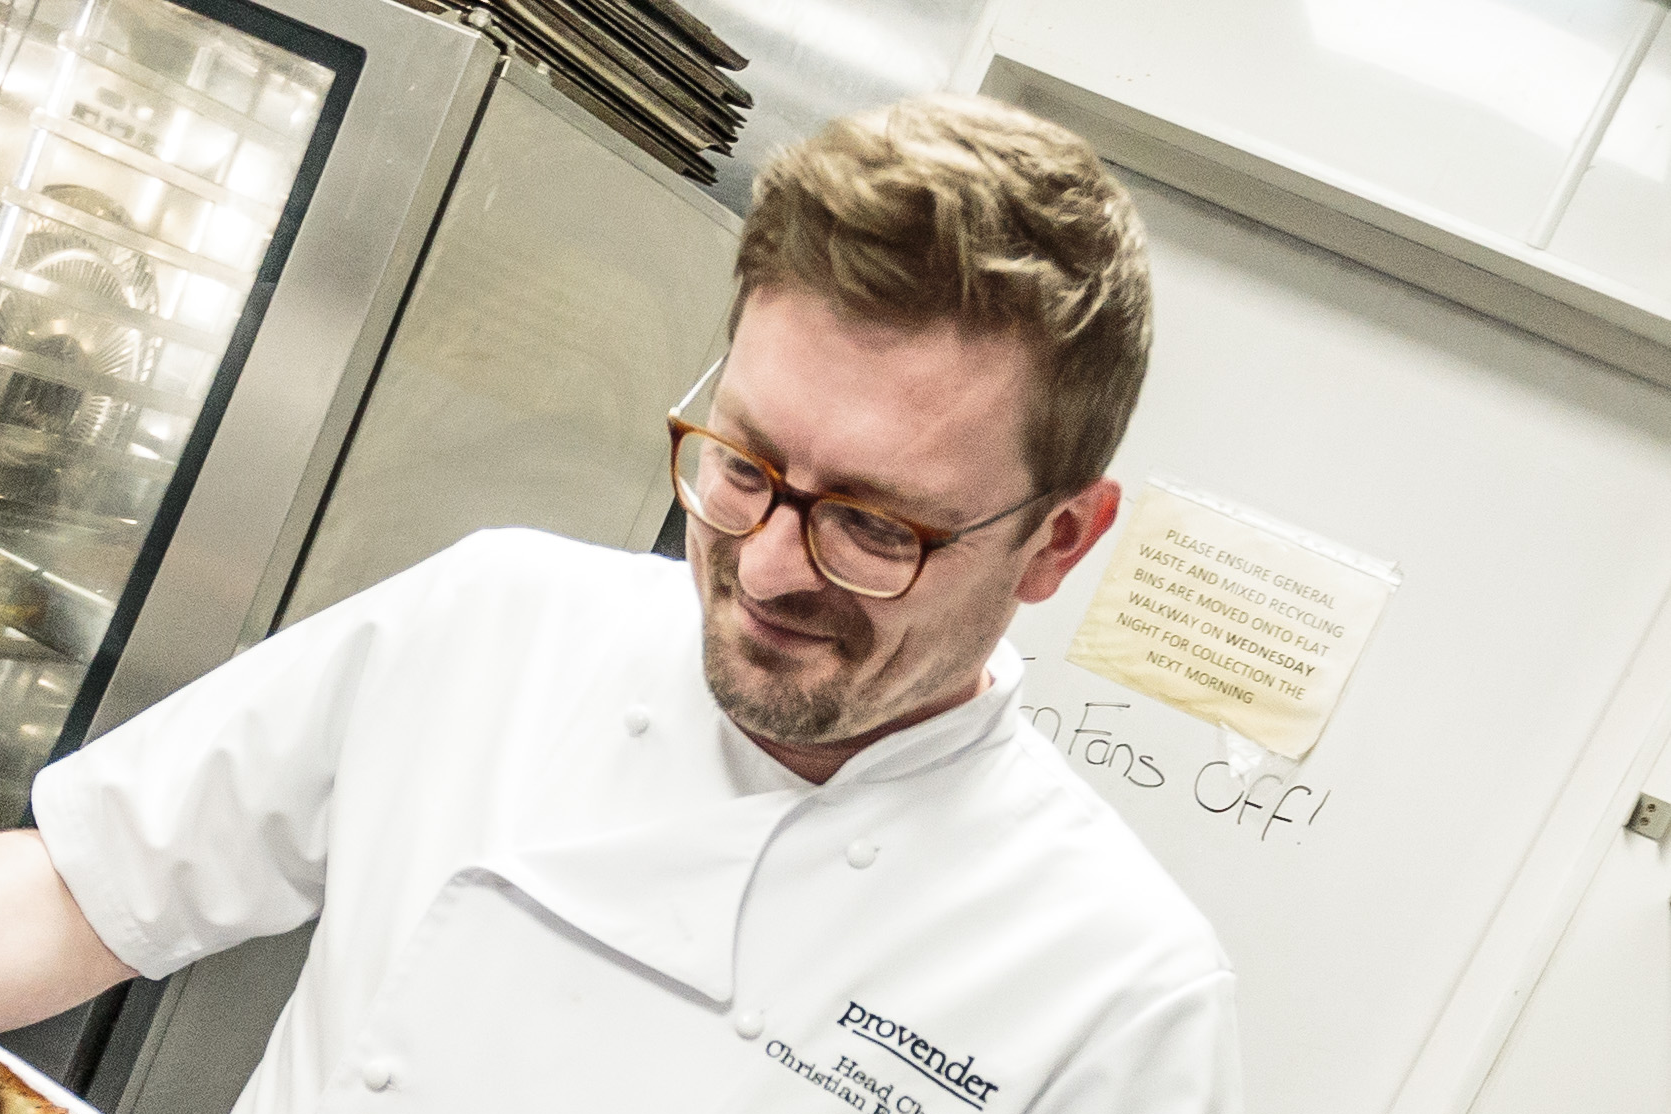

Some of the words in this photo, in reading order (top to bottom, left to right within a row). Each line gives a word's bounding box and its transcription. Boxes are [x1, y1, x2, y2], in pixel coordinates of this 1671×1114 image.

[1139, 543, 1185, 572] WASTE
[1186, 564, 1218, 586] AND
[1220, 577, 1266, 605] MIXED
[1268, 598, 1345, 638] RECYCLING
[1166, 529, 1215, 558] PLEASE
[1216, 551, 1271, 582] ENSURE
[1273, 574, 1336, 609] GENERAL
[1128, 591, 1200, 629] WALKWAY
[1200, 622, 1224, 640] ON
[1225, 631, 1316, 677] WEDNESDAY
[1133, 567, 1164, 589] BINS
[1165, 582, 1196, 602] ARE
[1196, 594, 1249, 625] MOVED
[1251, 617, 1293, 643] ONTO
[1294, 635, 1330, 658] FLAT
[1116, 612, 1160, 639] NIGHT
[1161, 630, 1190, 652] FOR
[1191, 643, 1275, 688] COLLECTION
[1278, 679, 1306, 701] THE
[1146, 650, 1182, 674] NEXT
[1184, 666, 1255, 705] MORNING
[1068, 702, 1165, 788] Fans
[766, 1039, 867, 1112] Christian
[832, 1055, 894, 1104] Head
[837, 1001, 999, 1104] provender
